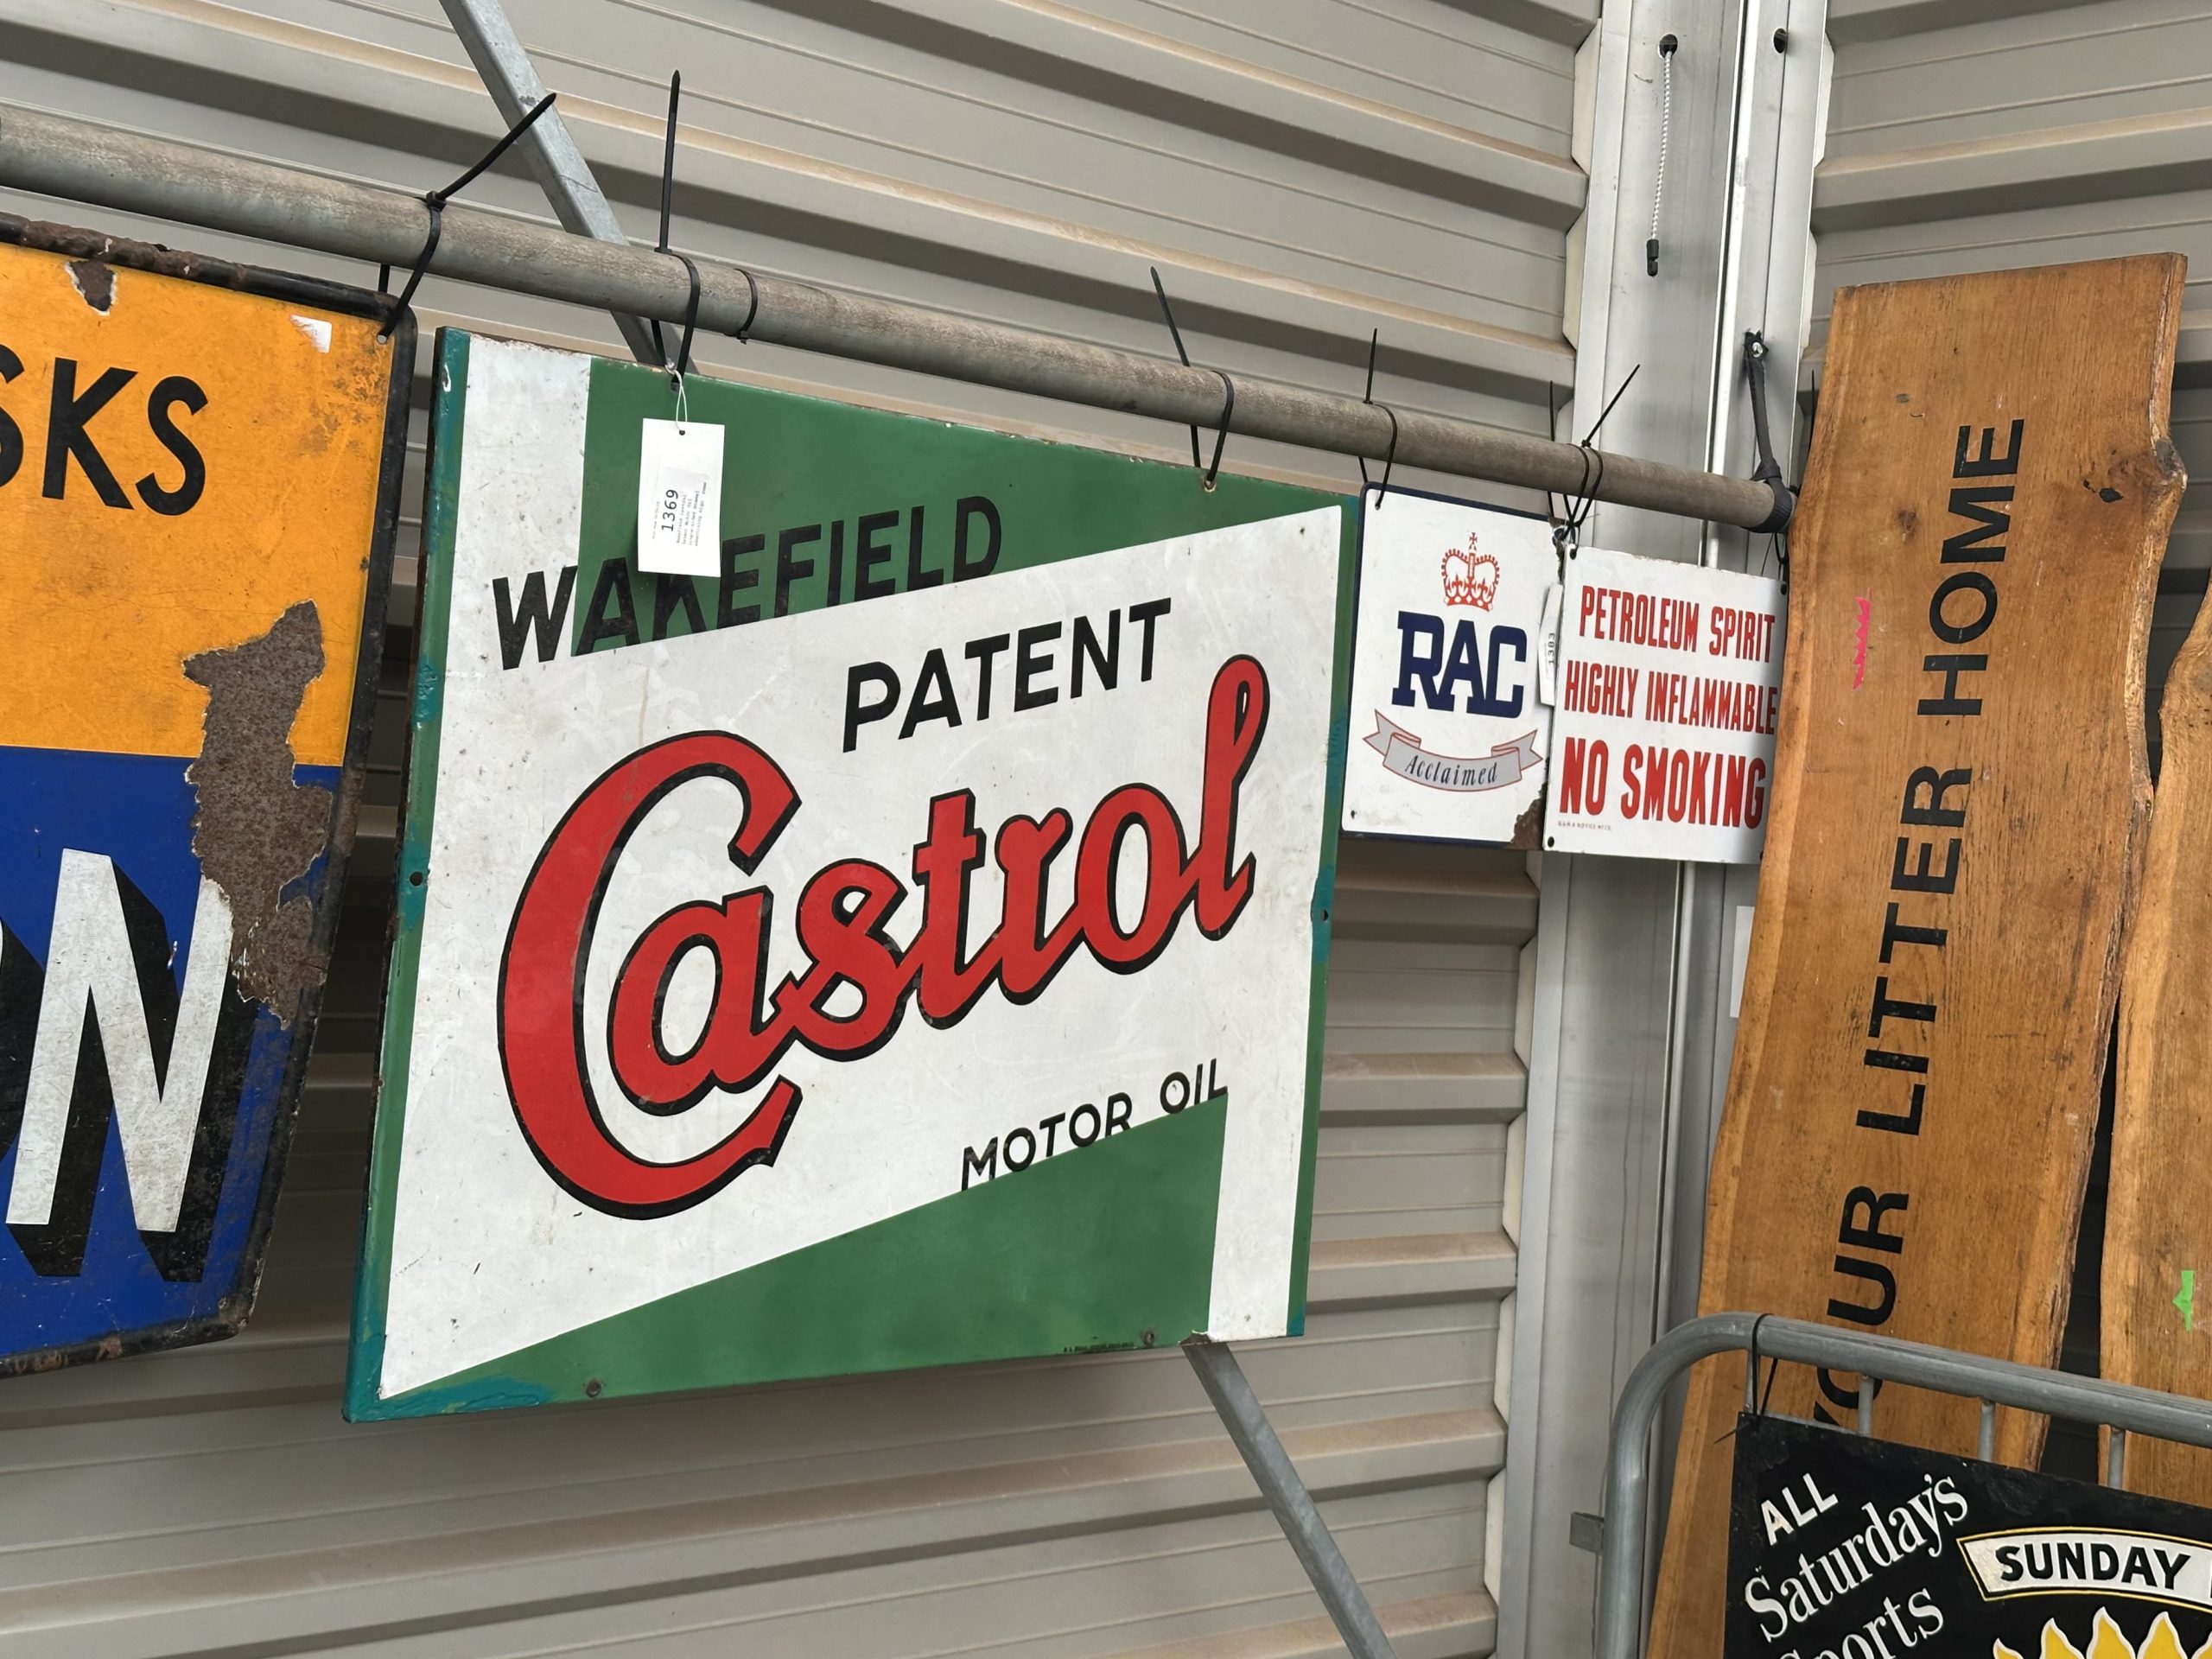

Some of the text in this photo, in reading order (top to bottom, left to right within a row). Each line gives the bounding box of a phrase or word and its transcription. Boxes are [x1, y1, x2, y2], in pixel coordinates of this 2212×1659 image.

[661, 489, 679, 532] 1369
[492, 495, 1002, 671] WAKEFIELD
[1579, 585, 1777, 663] PETROLEUM SPIRIT
[842, 598, 1172, 753] PATENT
[1391, 610, 1528, 719] RAC
[1564, 659, 1778, 734] HIGHLY INFLAMMABLE
[1404, 753, 1498, 787] Acclaimed
[1559, 736, 1767, 830] NO SMOKING
[497, 653, 1270, 1219] Castrol
[1813, 419, 2024, 1426] UR LITTER HOME
[961, 1058, 1228, 1192] MOTOR OIL
[1760, 1472, 1839, 1546] ALL
[1744, 1471, 1969, 1643] Saturday's
[1998, 1541, 2191, 1591] SUNDAY
[1779, 1587, 1944, 1659] orts
